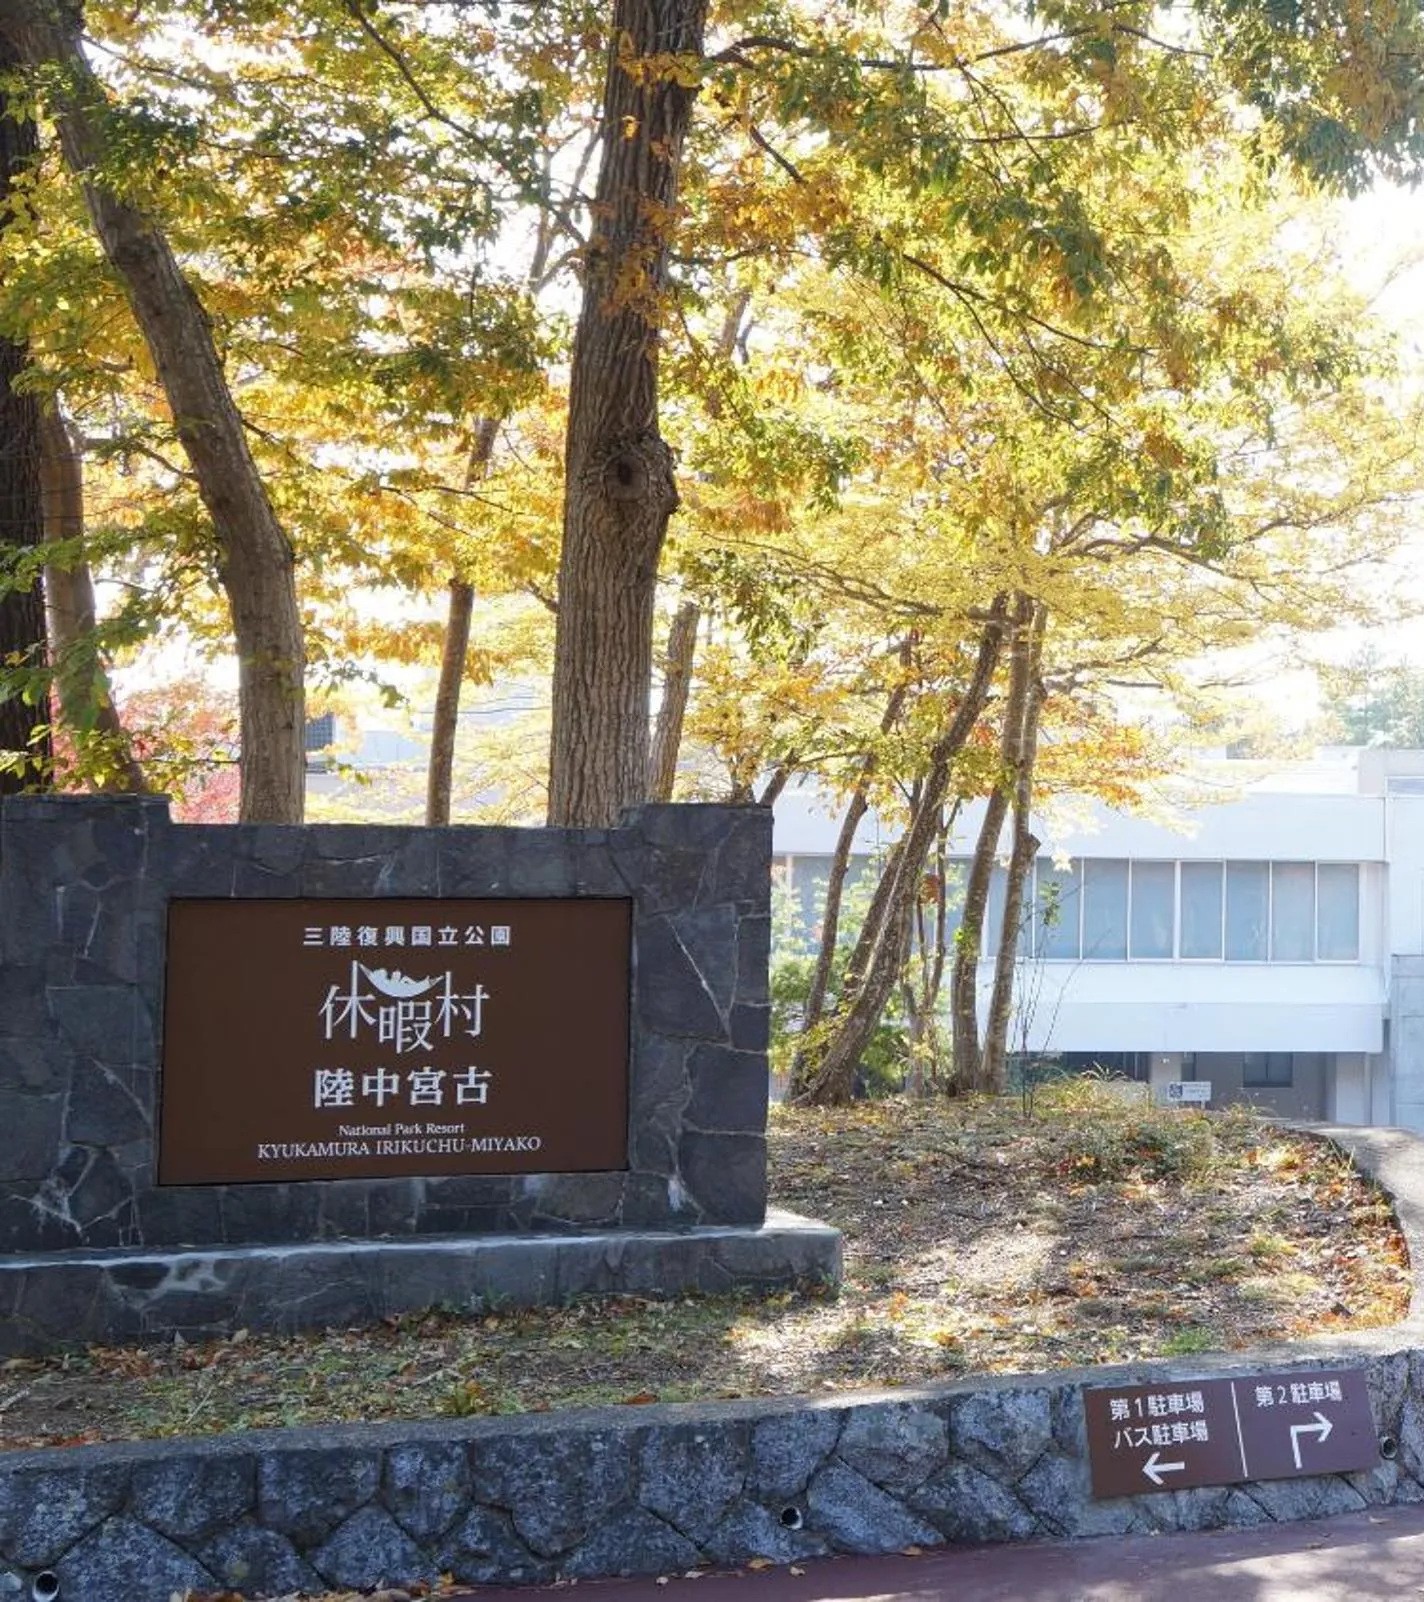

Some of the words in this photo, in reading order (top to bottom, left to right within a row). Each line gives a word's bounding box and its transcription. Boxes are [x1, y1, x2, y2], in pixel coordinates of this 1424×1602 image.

[303, 925, 511, 946] 三陸復興国立公園
[318, 959, 490, 1054] 休暇村
[314, 1066, 493, 1108] 陸中宮古
[339, 1124, 391, 1136] National
[395, 1123, 422, 1135] Park
[426, 1122, 465, 1134] Resort
[257, 1142, 370, 1160] KYUKAMURA
[1109, 1391, 1205, 1421] 第1駐車場
[1254, 1381, 1342, 1408] 第2駐車場
[1113, 1419, 1209, 1449] バス駐車場
